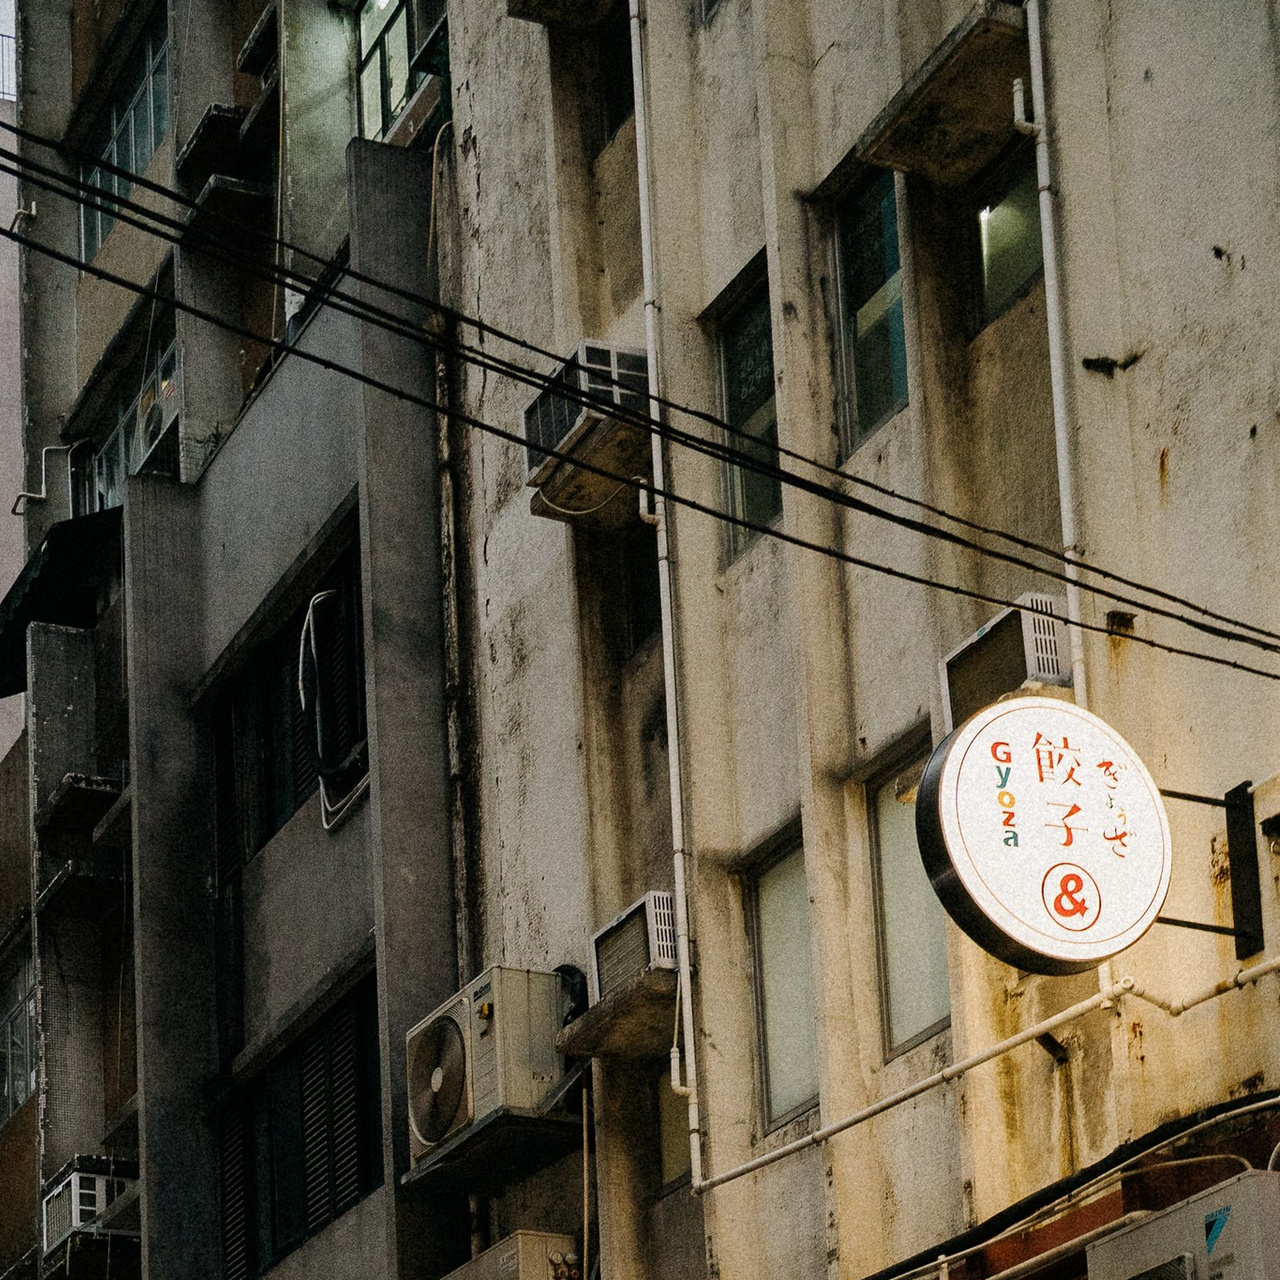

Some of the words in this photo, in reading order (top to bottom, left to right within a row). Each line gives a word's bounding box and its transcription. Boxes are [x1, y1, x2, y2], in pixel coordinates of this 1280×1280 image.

[990, 741, 1019, 847] Gyoza
[1031, 732, 1089, 847] 餃子
[1096, 757, 1137, 859] ぎょうざ
